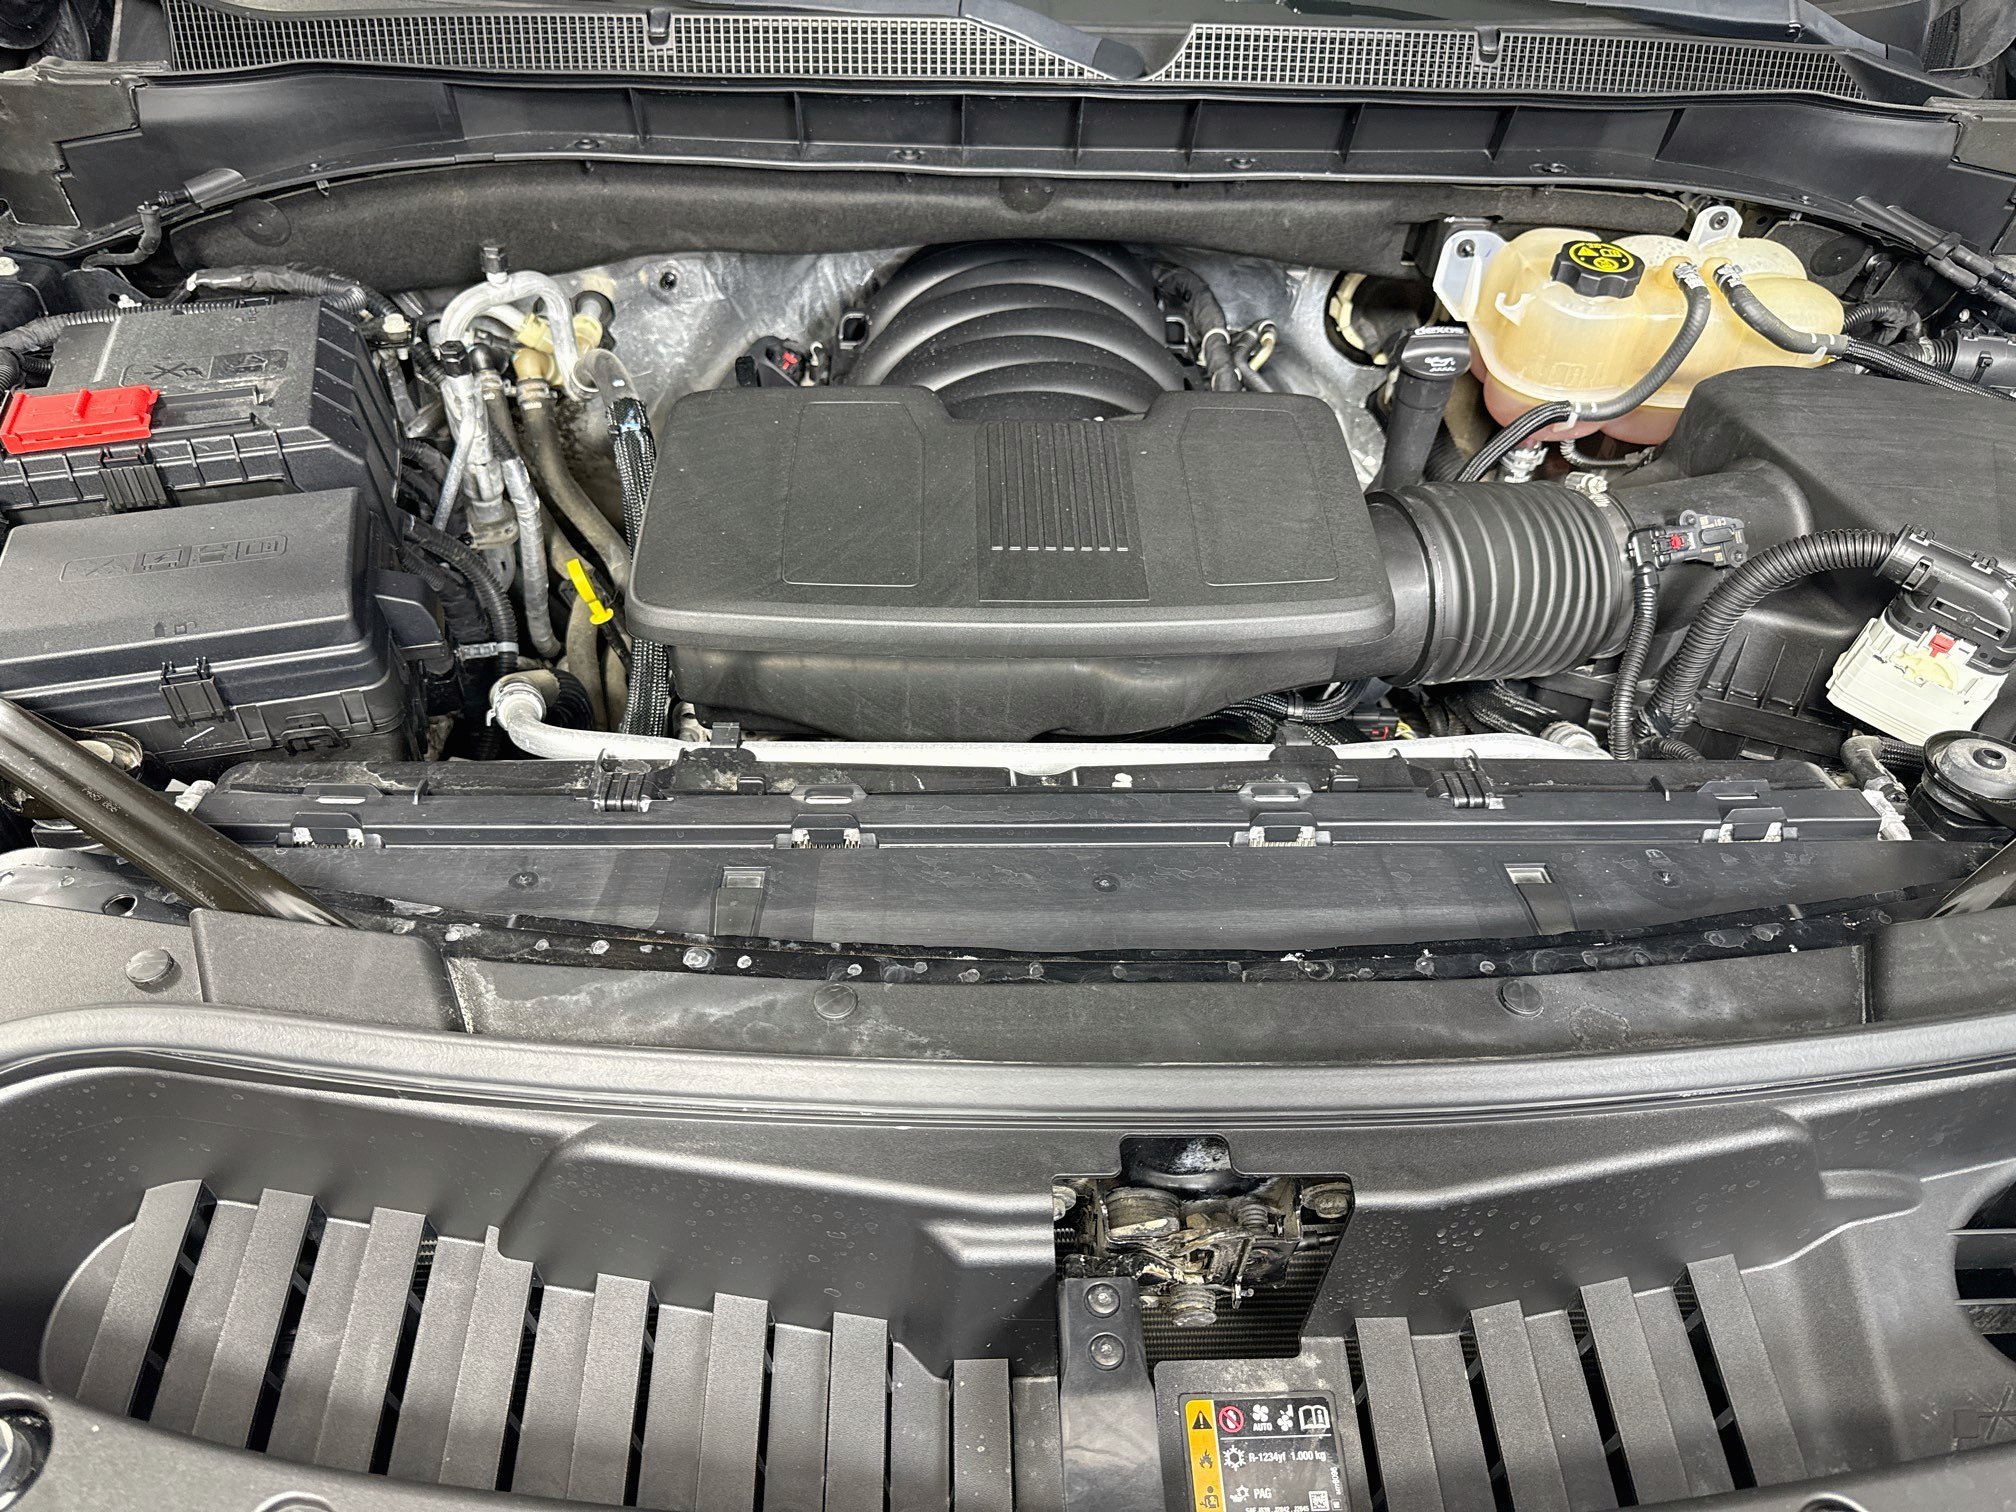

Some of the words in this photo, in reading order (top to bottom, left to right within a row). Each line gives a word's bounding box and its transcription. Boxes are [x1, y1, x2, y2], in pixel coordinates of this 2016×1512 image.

[1253, 1423, 1272, 1431] AUTO
[1248, 1452, 1286, 1463] R-1234yf
[1290, 1451, 1314, 1461] 1.000
[1315, 1450, 1326, 1462] kg
[1254, 1488, 1272, 1499] PAG
